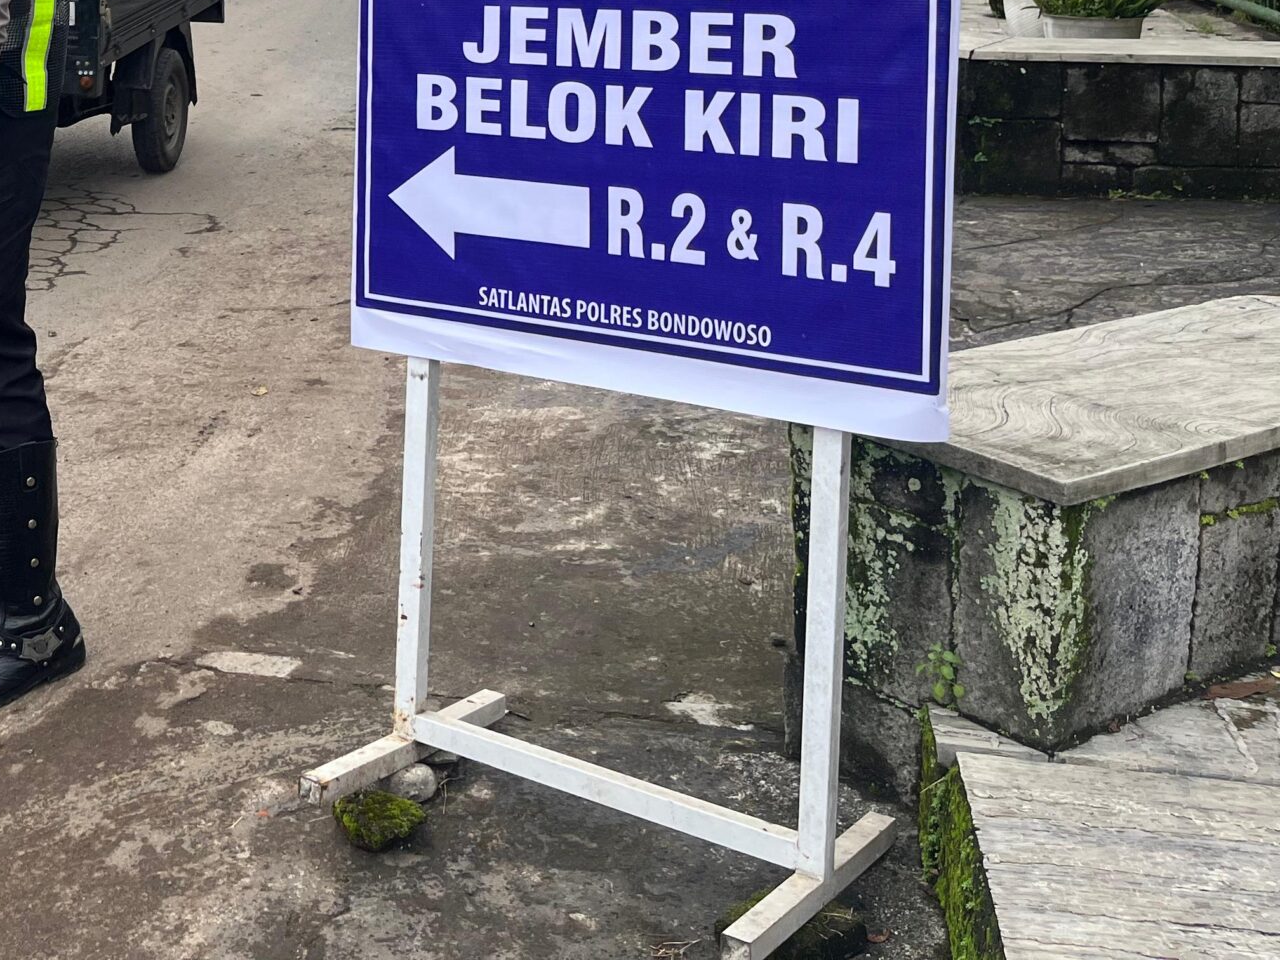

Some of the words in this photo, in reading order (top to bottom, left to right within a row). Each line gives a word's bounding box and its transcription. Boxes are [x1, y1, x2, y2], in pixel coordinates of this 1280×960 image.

[463, 5, 798, 79] JEMBER
[416, 74, 653, 148] BELOK
[685, 90, 860, 164] KIRI
[607, 186, 706, 266] R.2
[727, 208, 759, 262] &
[781, 202, 897, 288] R.4
[478, 286, 572, 319] SATLANTAS
[576, 299, 642, 329] POLRES
[647, 309, 772, 348] BONDOWOSO
